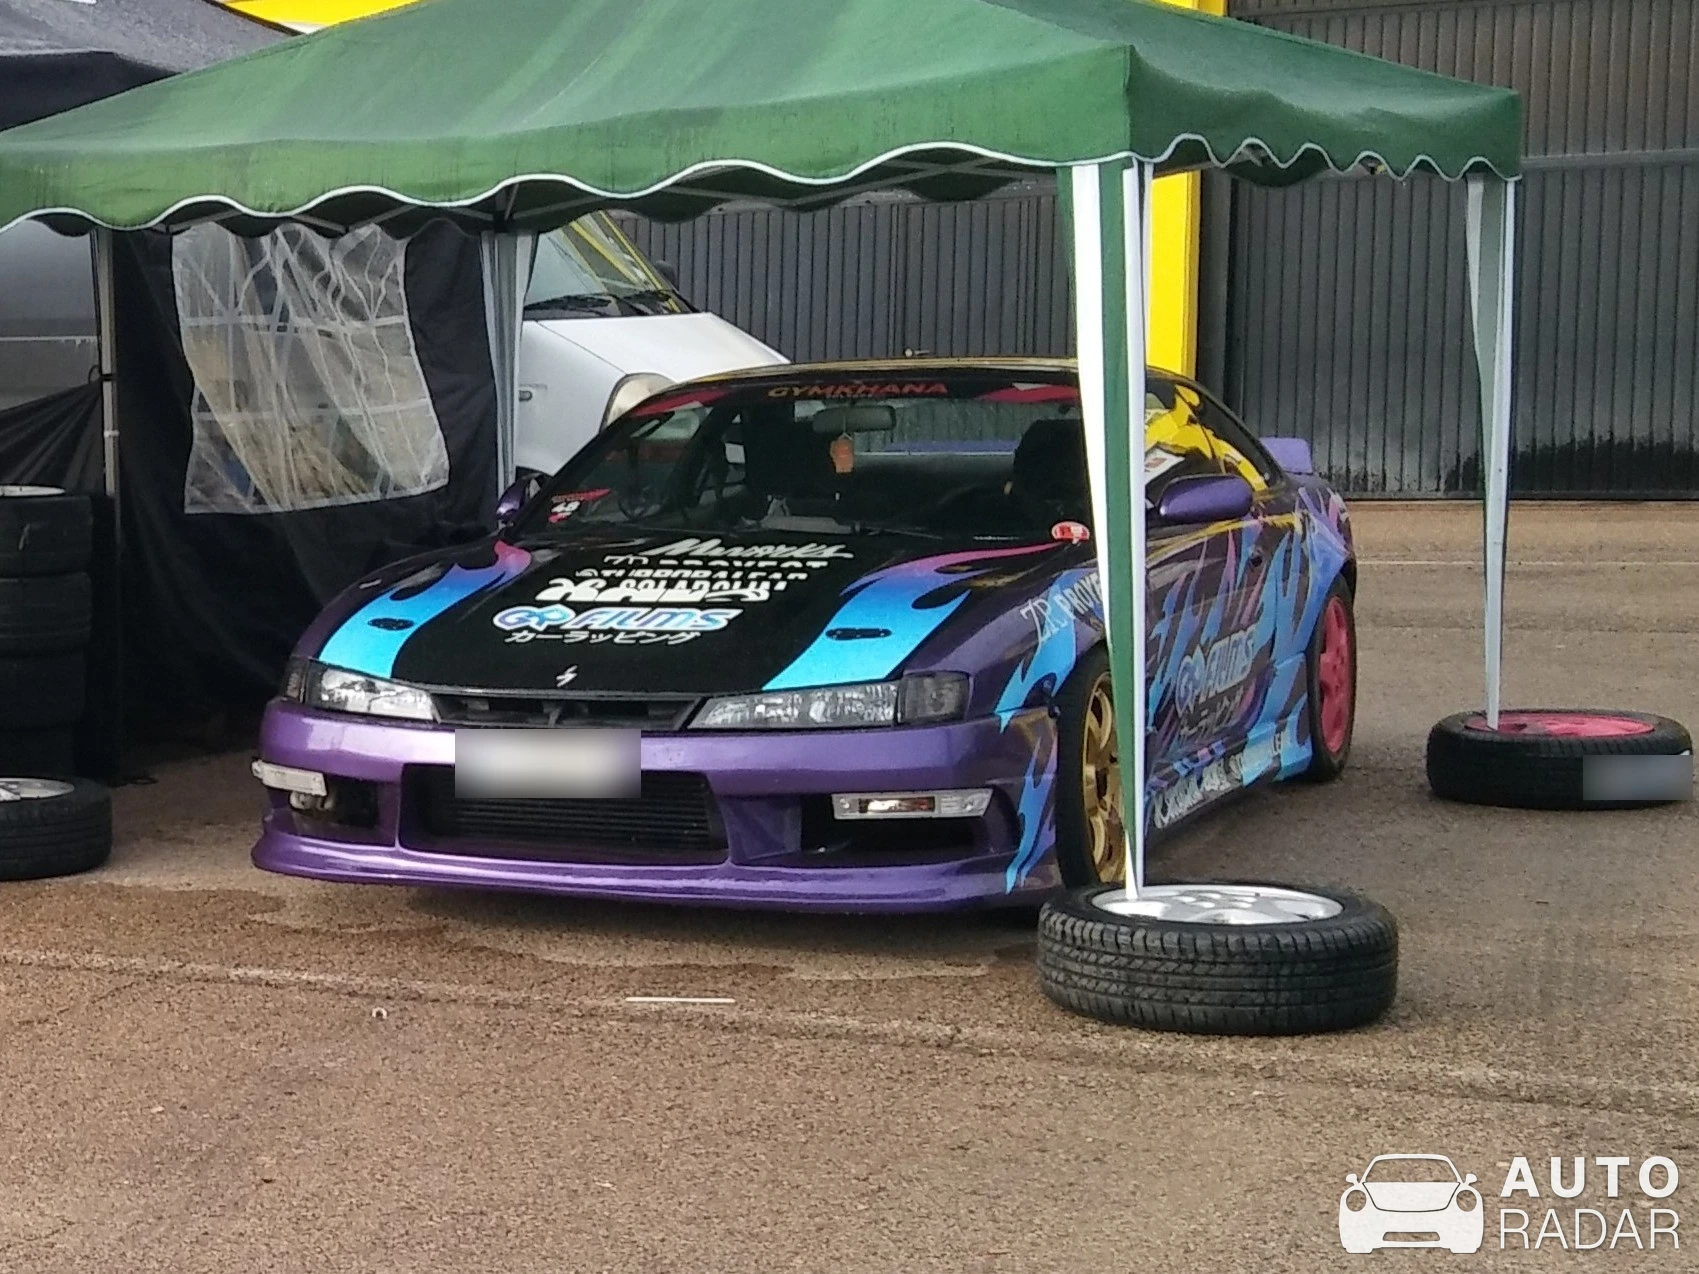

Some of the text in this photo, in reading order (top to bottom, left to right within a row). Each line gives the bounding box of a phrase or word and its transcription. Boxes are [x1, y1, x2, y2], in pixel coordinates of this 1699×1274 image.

[768, 383, 948, 398] GYMKHANA
[505, 630, 701, 645] カーラッピング
